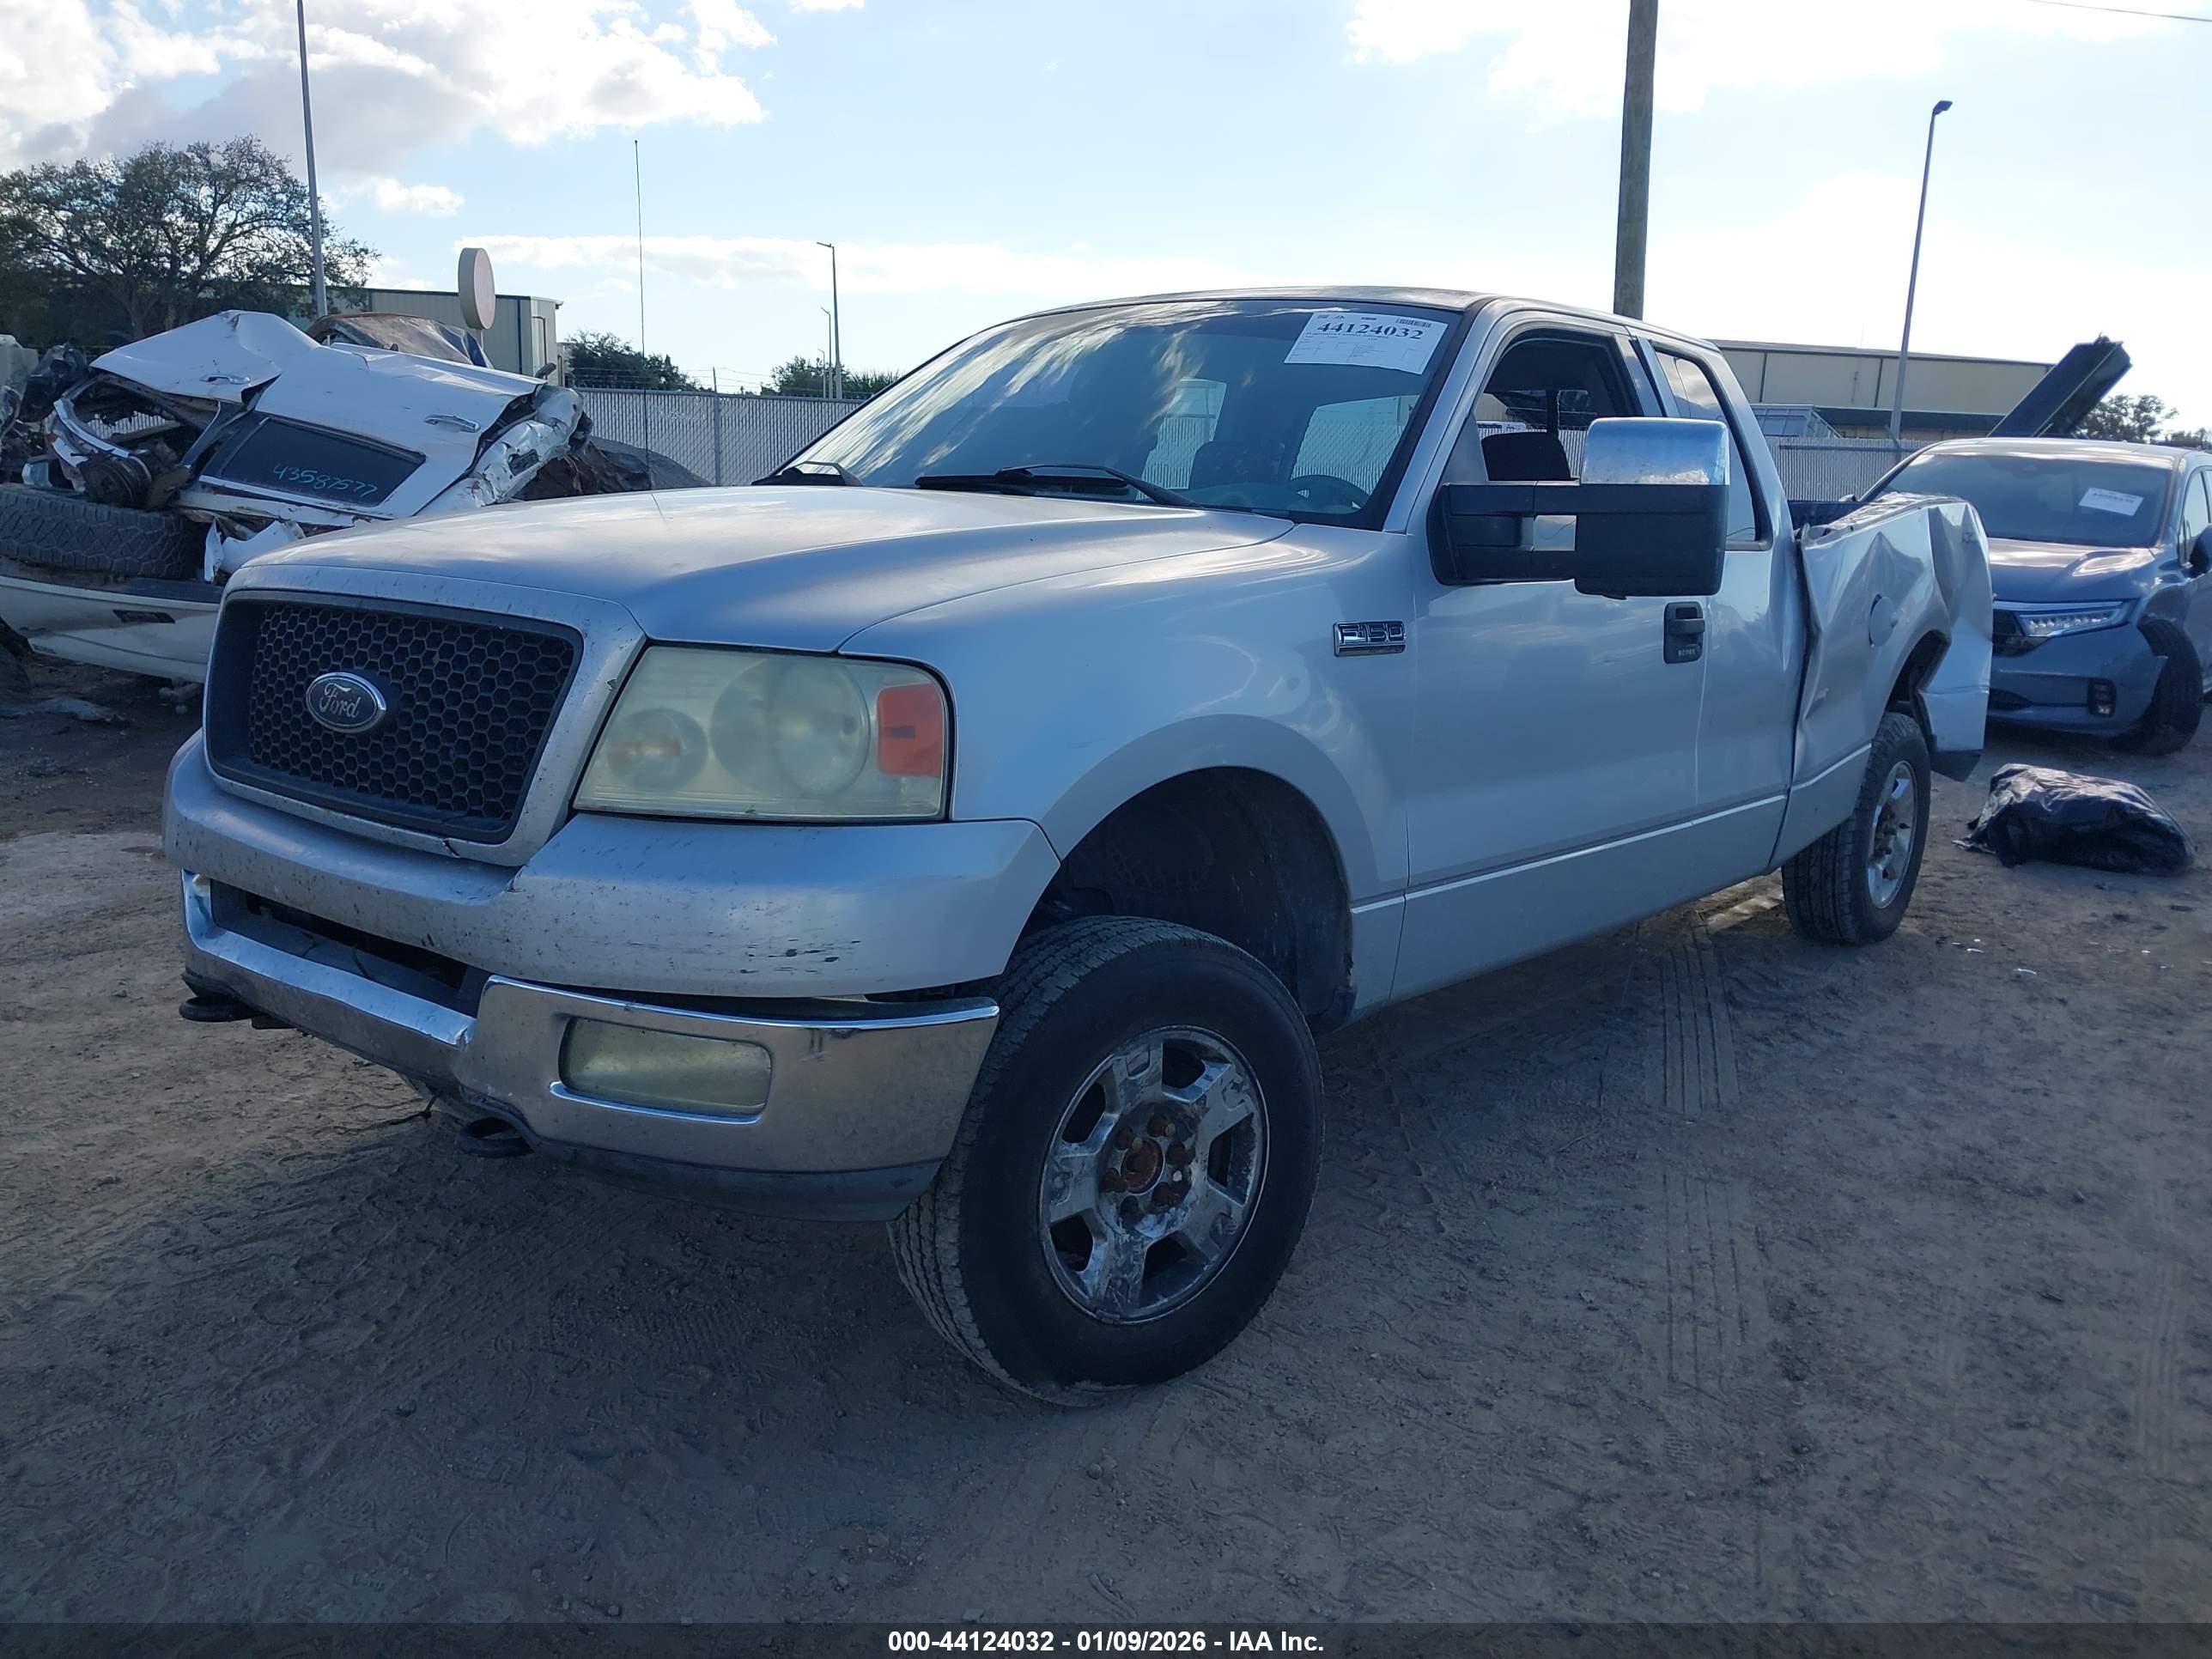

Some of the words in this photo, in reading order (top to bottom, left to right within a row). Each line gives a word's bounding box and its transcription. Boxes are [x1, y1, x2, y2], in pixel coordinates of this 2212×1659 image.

[1317, 323, 1424, 340] 44124032
[272, 464, 379, 498] 43587577
[319, 682, 362, 719] Ford
